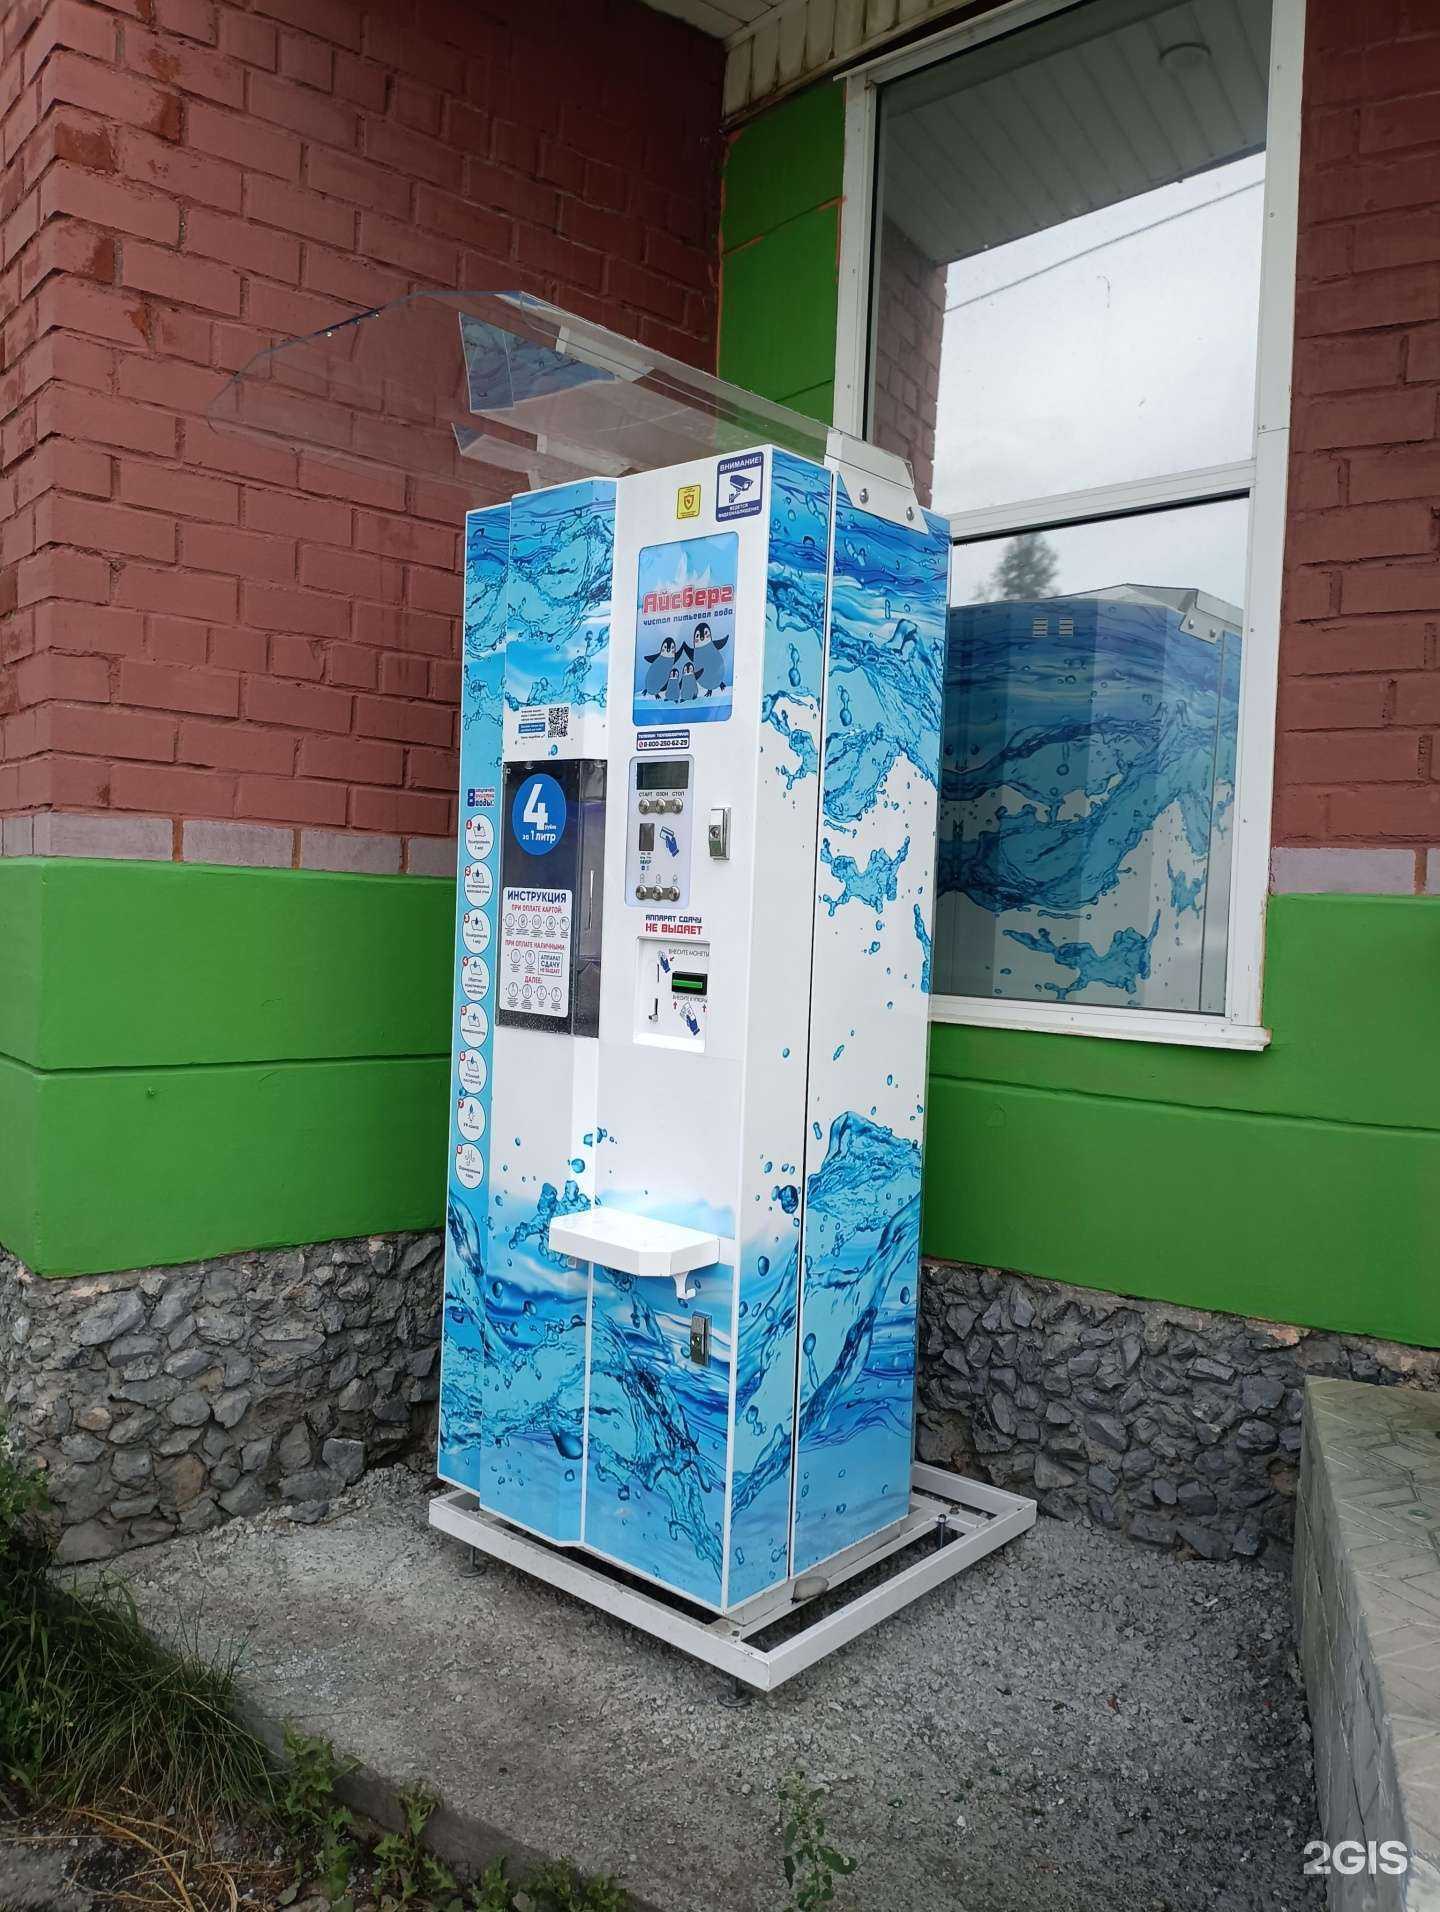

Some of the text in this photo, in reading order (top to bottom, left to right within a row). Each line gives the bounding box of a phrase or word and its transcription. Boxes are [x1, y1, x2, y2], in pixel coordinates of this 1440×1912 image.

[720, 456, 762, 472] ВНИМАНИЕ!
[523, 783, 548, 830] 4
[531, 831, 535, 840] 1
[535, 833, 556, 843] литр
[507, 890, 567, 904] ИНСТРУКЦИЯ
[645, 914, 676, 922] АППАРАТ
[646, 923, 702, 935] НЕ ВЫДАЕТ
